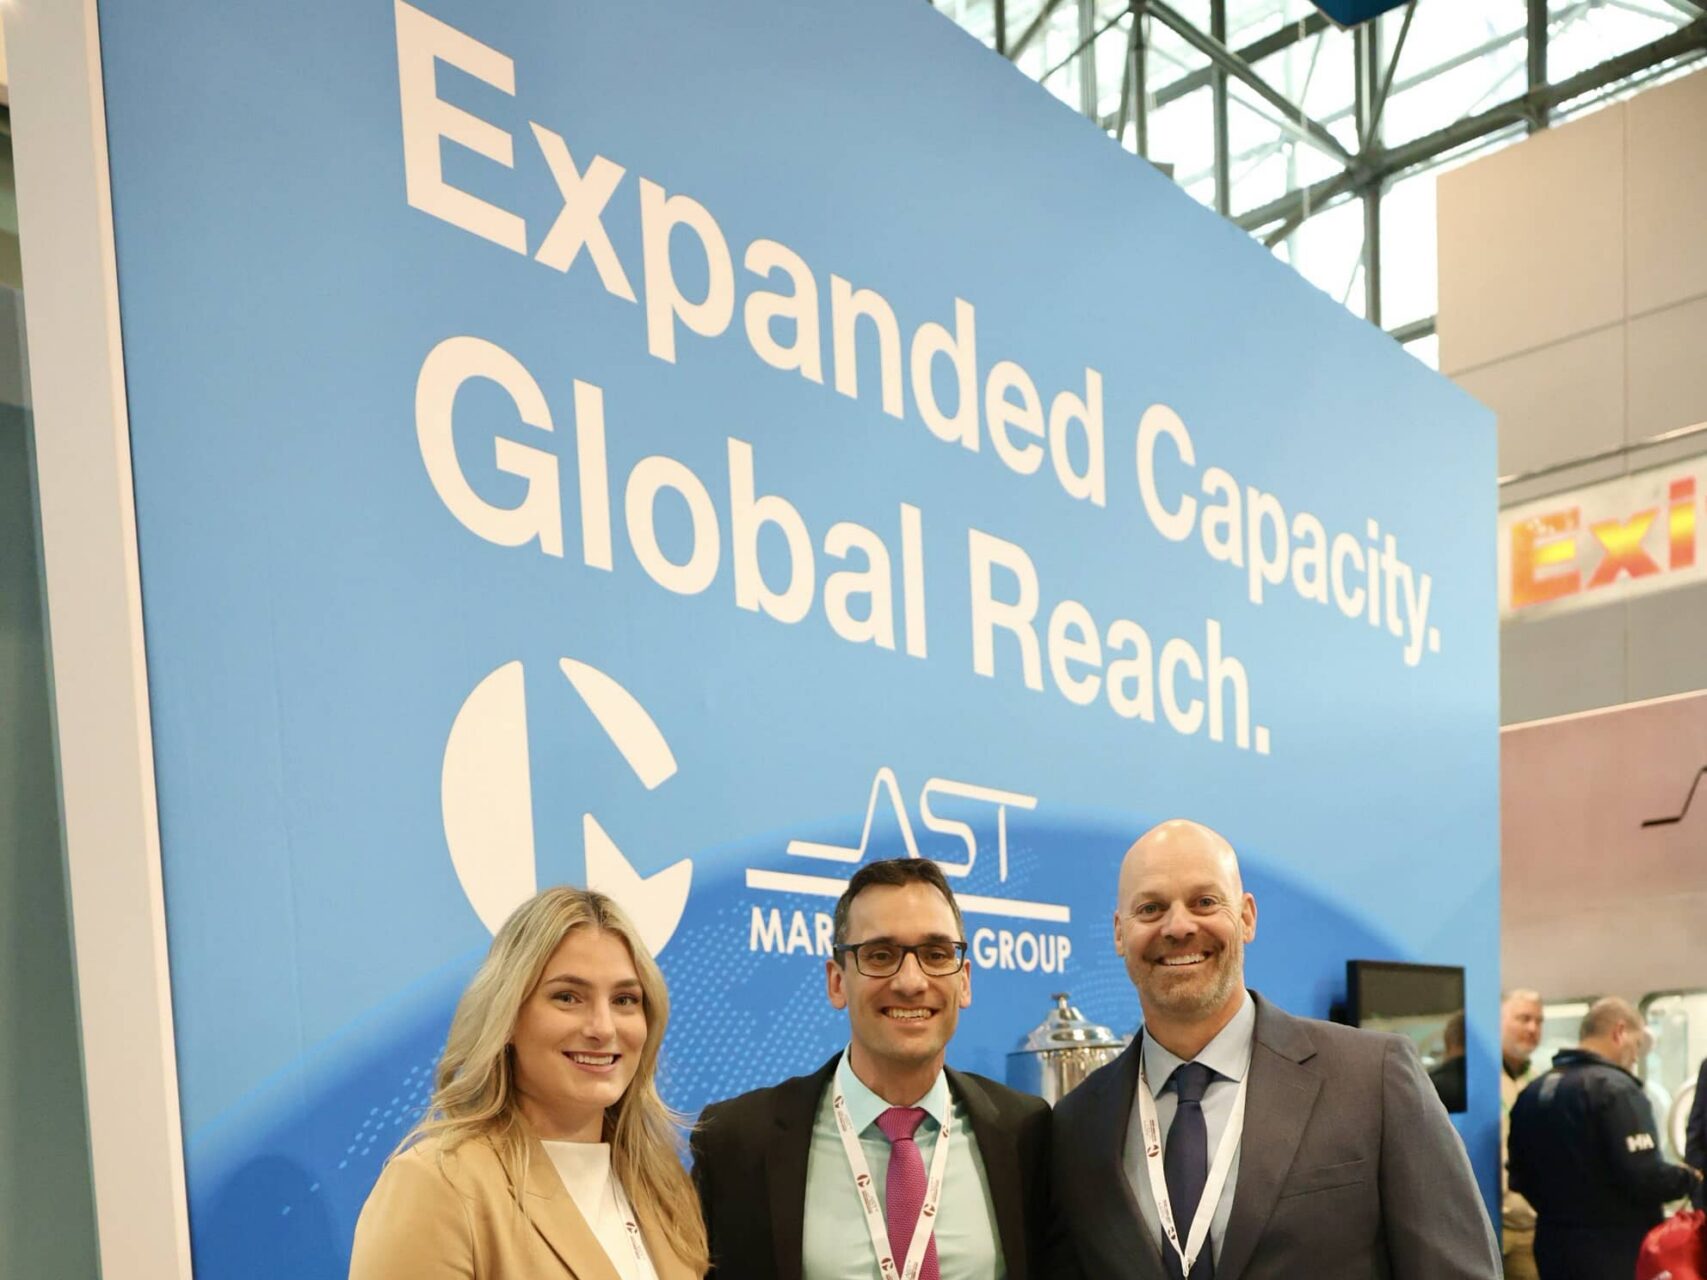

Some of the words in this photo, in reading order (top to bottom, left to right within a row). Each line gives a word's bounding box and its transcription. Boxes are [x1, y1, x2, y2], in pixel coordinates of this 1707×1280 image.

[394, 0, 1105, 508] Expanded
[1136, 403, 1441, 666] Capacity.
[415, 336, 927, 659] Global
[969, 527, 1271, 755] Reach.
[1510, 475, 1707, 611] Exi
[786, 766, 1038, 883] AST
[973, 928, 1071, 973] GROUP
